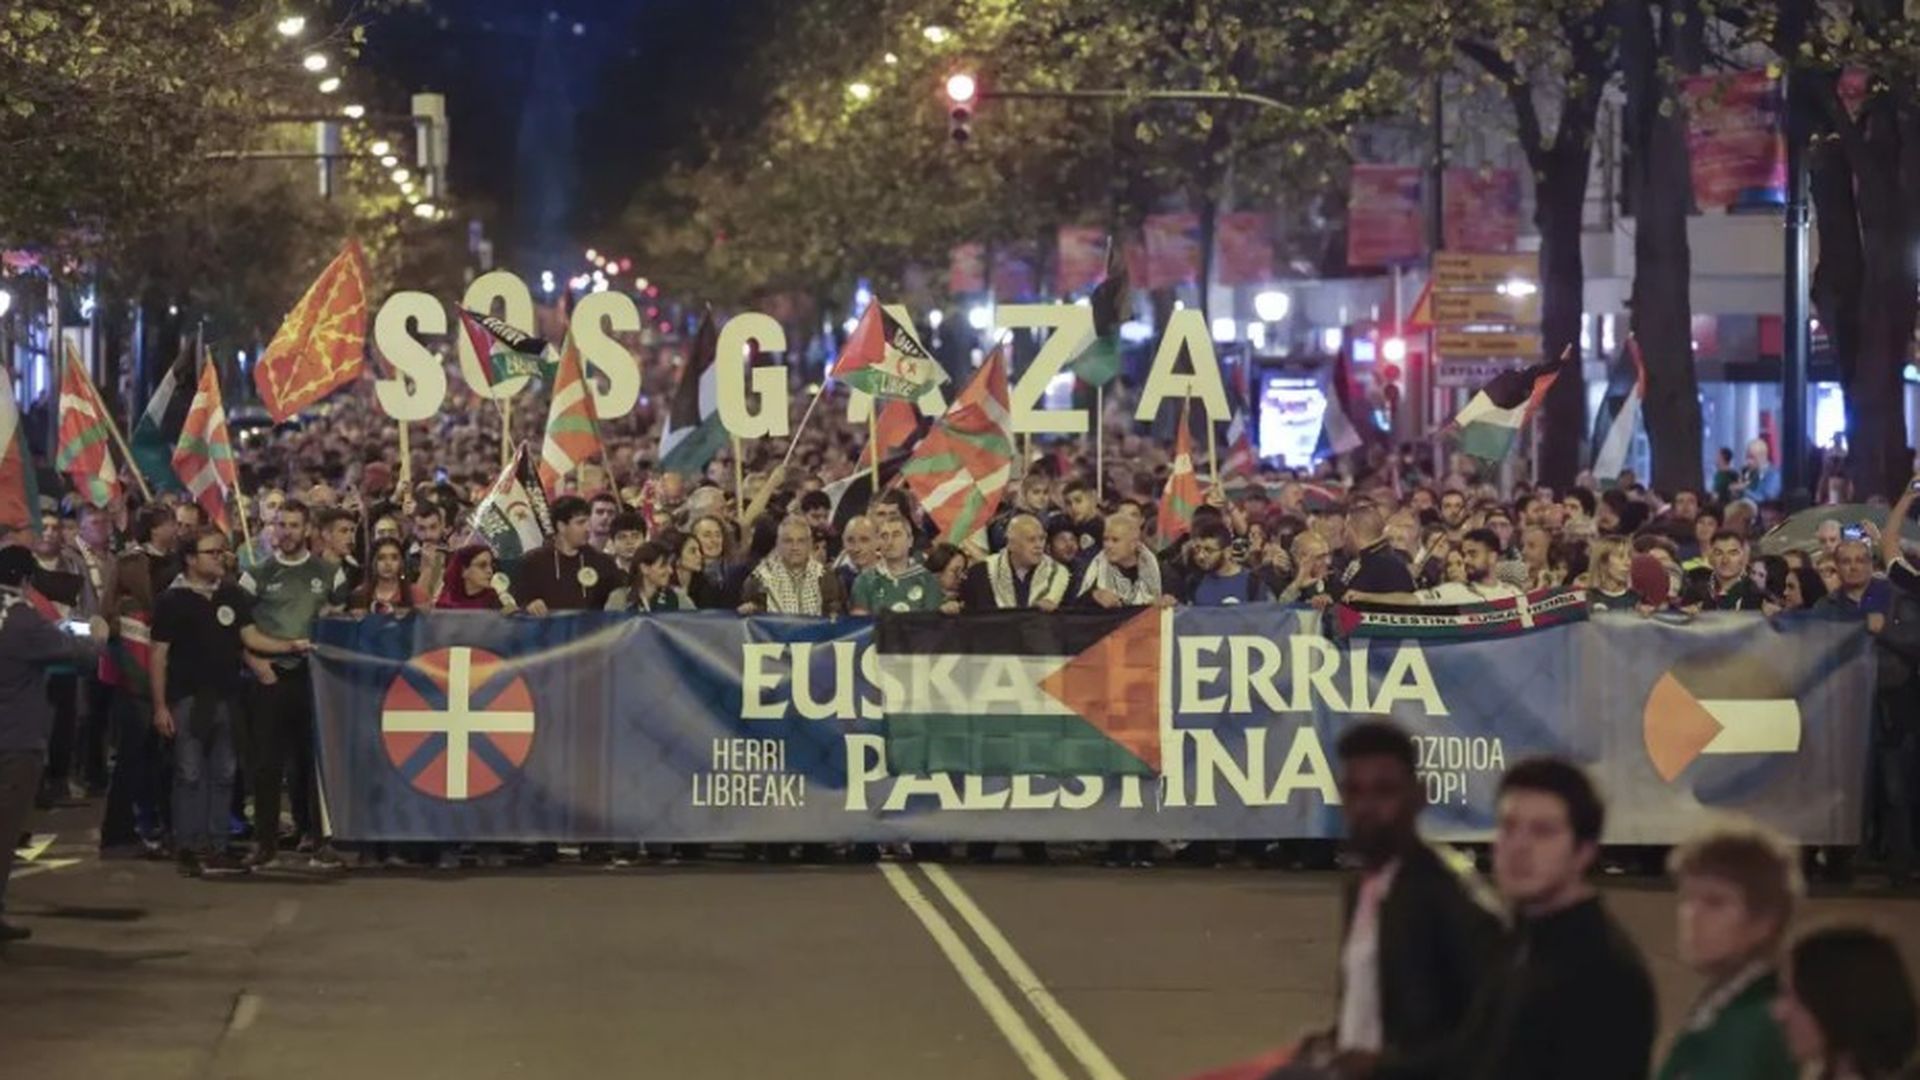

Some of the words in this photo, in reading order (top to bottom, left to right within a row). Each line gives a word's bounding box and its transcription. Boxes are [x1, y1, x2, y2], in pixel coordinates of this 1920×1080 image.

[375, 270, 641, 420] SOS
[1368, 613, 1458, 625] PALESTINA
[712, 738, 785, 772] HERRI
[1409, 735, 1505, 771] OZIDIOA
[692, 772, 805, 807] LIBREAK!
